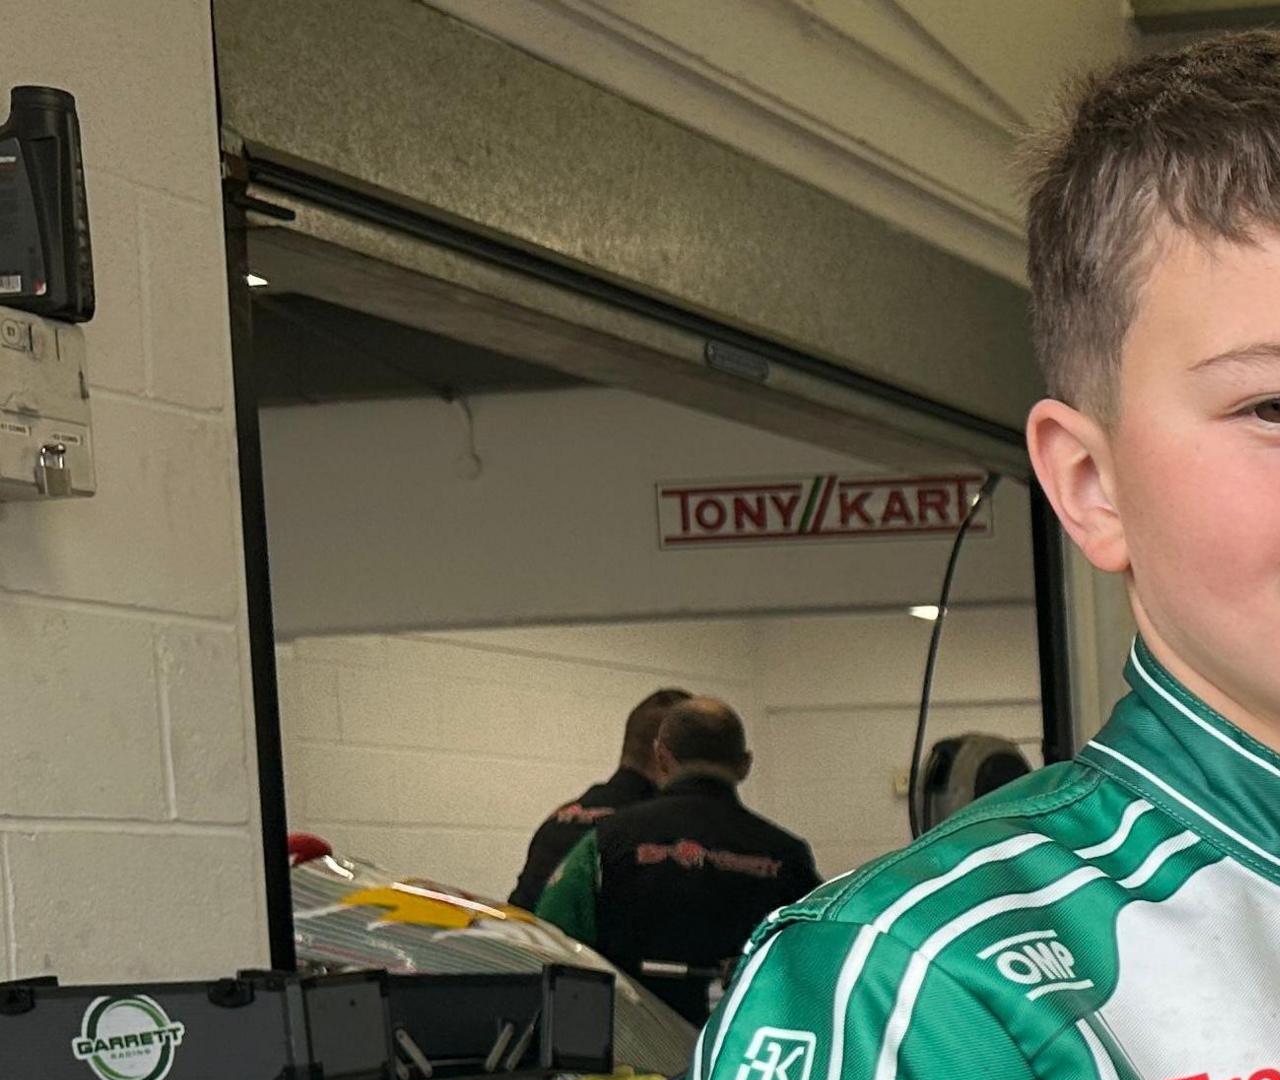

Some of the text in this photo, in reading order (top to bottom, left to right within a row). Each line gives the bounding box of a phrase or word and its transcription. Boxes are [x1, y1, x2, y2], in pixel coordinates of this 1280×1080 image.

[662, 476, 982, 534] TONY KART
[997, 940, 1076, 985] OMP
[77, 1027, 181, 1055] GARRETT
